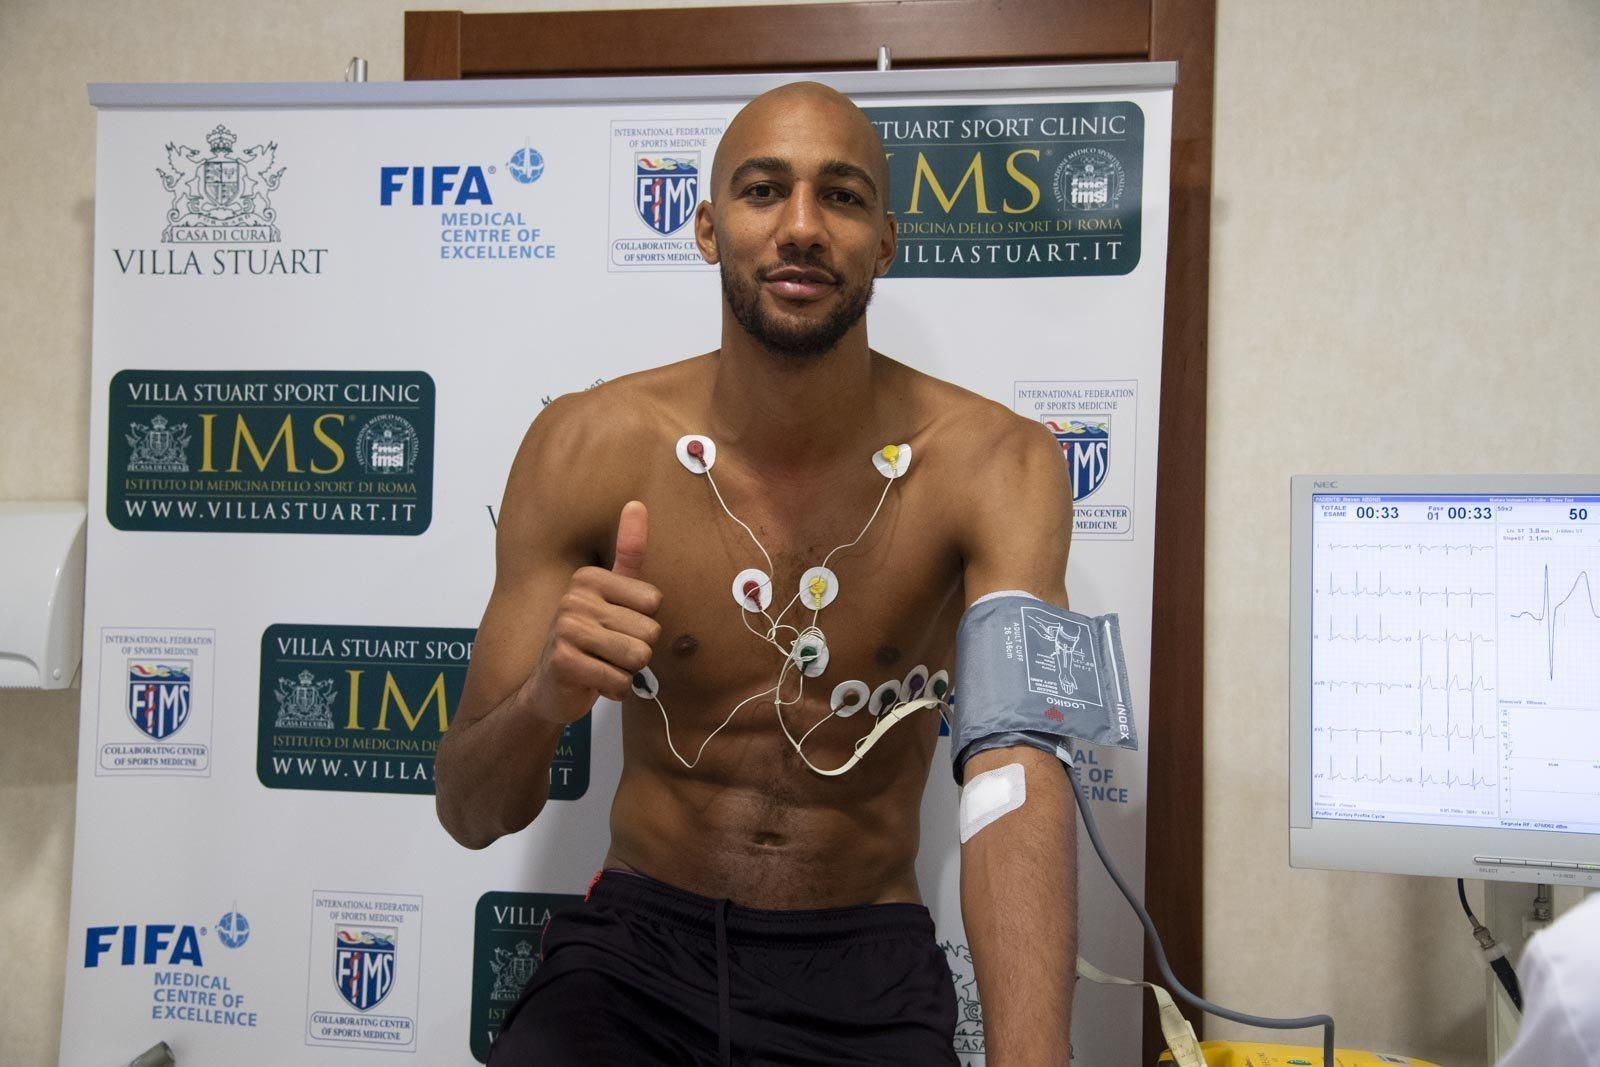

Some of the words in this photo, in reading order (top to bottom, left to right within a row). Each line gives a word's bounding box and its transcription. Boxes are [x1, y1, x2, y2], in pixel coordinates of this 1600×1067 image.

[614, 128, 673, 137] INTERNATIONAL
[676, 127, 722, 136] FEDERATION
[872, 120, 954, 139] TUART
[961, 119, 1033, 138] SPORT
[1041, 116, 1126, 136] CLINIC
[629, 140, 639, 148] OF
[641, 140, 667, 148] SPORTS
[670, 139, 707, 147] MEDICINE
[380, 166, 493, 206] FIFA
[886, 149, 1040, 214] MS
[441, 212, 526, 226] MEDICAL
[897, 222, 955, 234] EDICINA
[958, 221, 1003, 233] DELLO
[1008, 220, 1051, 232] SPORT
[1056, 220, 1071, 231] DI
[1078, 218, 1122, 231] ROMA
[176, 229, 209, 241] CASA
[212, 229, 226, 241] DI
[230, 229, 266, 241] CURA
[441, 229, 510, 243] CENTRE
[517, 229, 541, 242] OF
[440, 245, 556, 259] EXCELLENCE
[615, 242, 682, 251] COLLABORATING
[897, 241, 1122, 263] ILLASTUART.IT
[112, 249, 203, 275] VILLA
[213, 249, 329, 275] STUART
[636, 253, 665, 261] SPORTS
[667, 253, 704, 261] MEDICIN
[128, 383, 188, 401] VILLA
[194, 383, 268, 402] STUART
[273, 383, 339, 402] SPORT
[344, 384, 420, 402] CLINIC
[1018, 390, 1082, 398] INTERNATIONAL
[1084, 389, 1134, 398] FEDERATION
[1034, 402, 1045, 410] OF
[1046, 402, 1076, 410] SPORTS
[1078, 401, 1117, 410] MEDICINE
[198, 413, 345, 474] IMS
[125, 478, 186, 490] ISTITUTO
[190, 479, 203, 490] DI
[207, 480, 268, 491] MEDICINA
[271, 480, 310, 492] DELLO
[314, 481, 353, 492] SPORT
[359, 482, 372, 493] DI
[377, 482, 416, 493] ROMA
[124, 500, 416, 522] WWW.VILLASTUART.IT
[1094, 509, 1127, 517] CENTER
[1356, 506, 1399, 519] 00:33
[1448, 507, 1492, 520] 00:33
[1427, 512, 1439, 521] 01
[1569, 508, 1588, 520] 50
[1076, 521, 1118, 529] MEDICINE
[105, 635, 168, 645] INTERNATIONAL
[169, 636, 213, 645] FEDERATION
[121, 646, 132, 655] OF
[133, 646, 162, 655] SPORTS
[164, 647, 199, 656] MEDICINE
[277, 637, 335, 656] VILLA
[341, 639, 420, 659] STUART
[425, 641, 474, 660] SPO
[344, 670, 449, 732] IM
[1046, 697, 1086, 710] LOGIKO
[1116, 703, 1129, 740] INDEX
[273, 735, 331, 747] ISTITUTO
[334, 736, 348, 748] DI
[353, 737, 419, 750] MEDICINA
[104, 746, 175, 755] COLLABORATING
[177, 747, 206, 756] CENTER
[127, 758, 158, 766] SPORTS
[160, 758, 197, 766] MEDICINE
[272, 756, 435, 780] WWW.VILLA
[1089, 769, 1113, 783] OF
[316, 899, 373, 910] INTERNATIONAL
[375, 902, 419, 912] FEDERATION
[330, 911, 340, 920] OF
[341, 911, 367, 921] SPORTS
[369, 913, 404, 923] MEDICINE
[84, 925, 203, 968] FIFA
[154, 972, 231, 991] MEDICAL
[153, 989, 217, 1006] CENTRE
[222, 994, 244, 1009] OF
[152, 1005, 257, 1027] EXCELLENCE
[313, 1015, 378, 1027] COLLABORATING
[379, 1018, 410, 1029] CENTER
[321, 1027, 332, 1036] OF
[334, 1028, 361, 1038] SPORTS
[363, 1029, 401, 1040] MEDICINE
